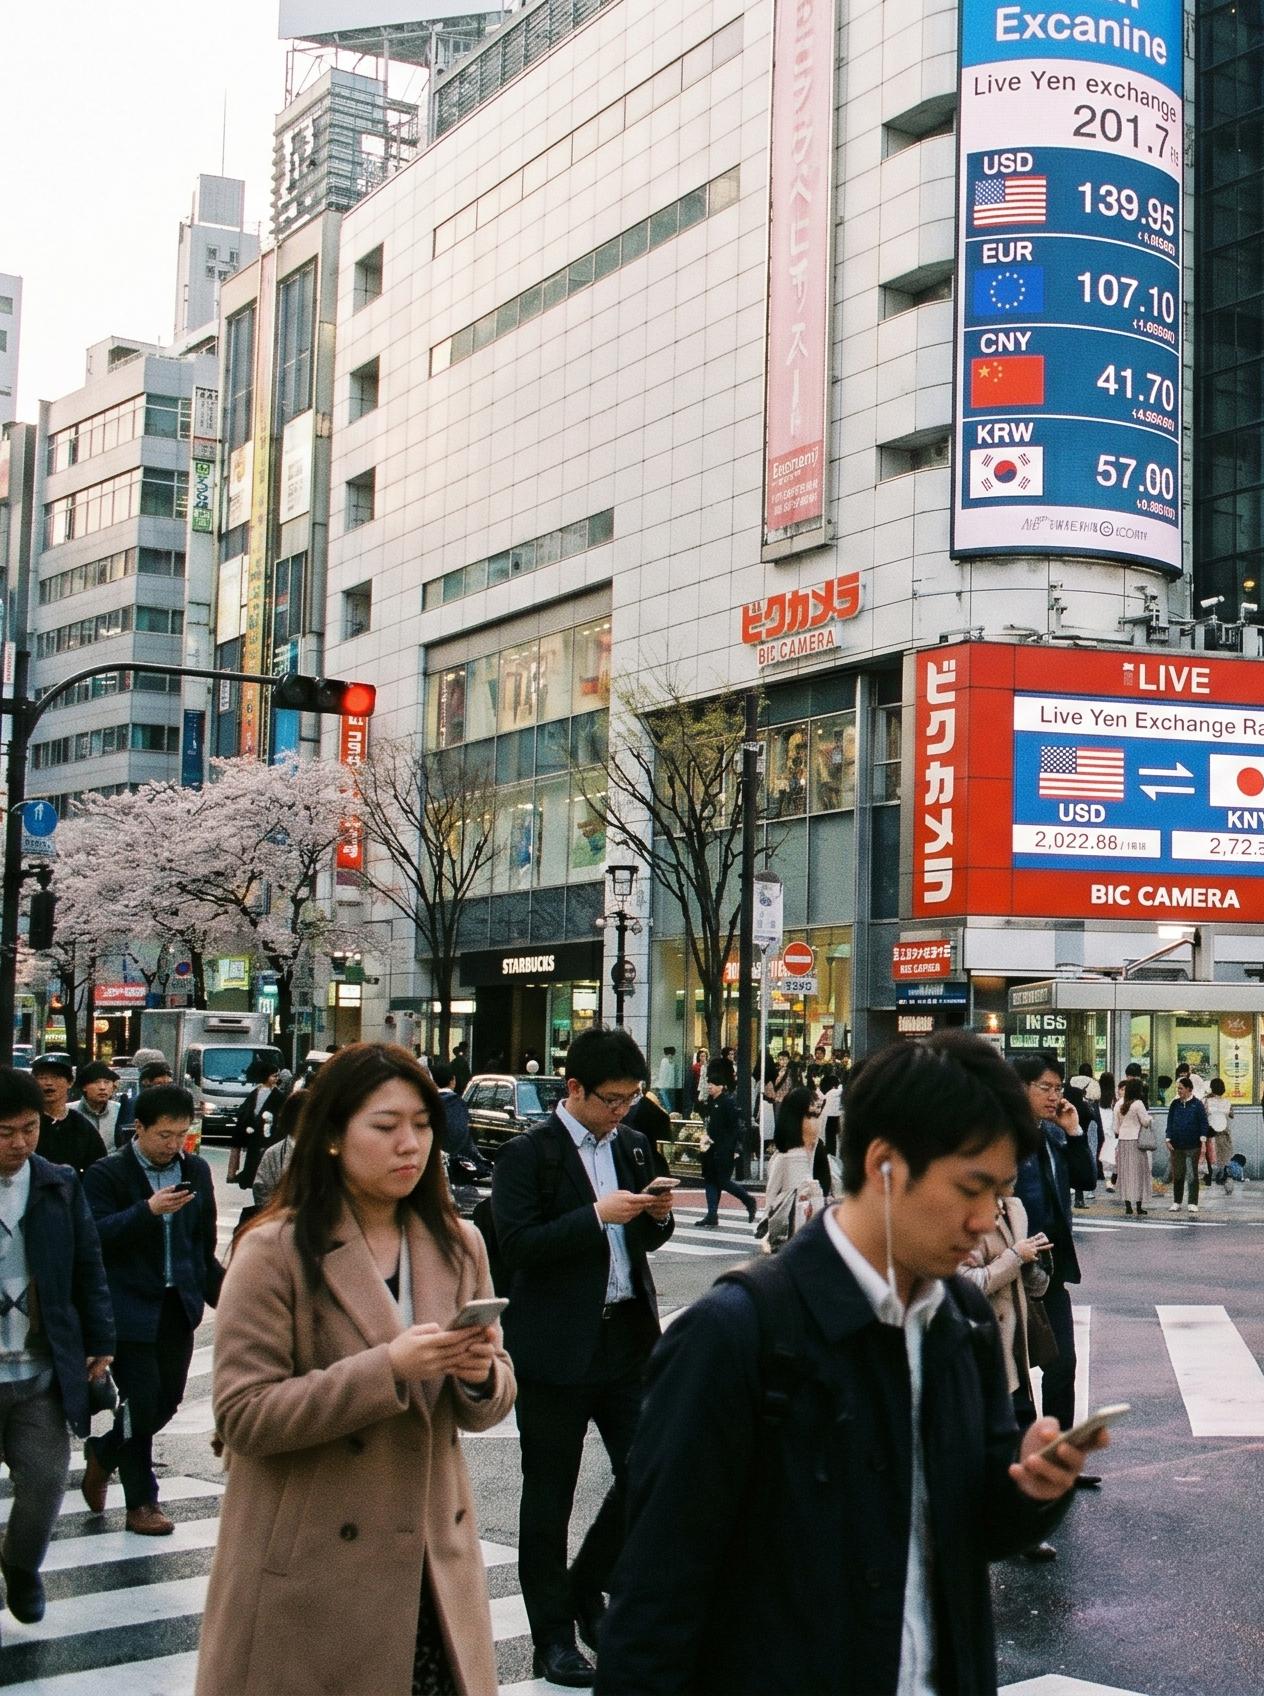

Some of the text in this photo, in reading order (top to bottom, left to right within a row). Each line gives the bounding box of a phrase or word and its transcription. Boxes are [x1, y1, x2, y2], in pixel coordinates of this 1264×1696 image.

[995, 6, 1168, 66] Excanine
[974, 71, 1177, 123] Live Yen exchange
[1072, 104, 1170, 158] 201.7
[983, 152, 1033, 175] USD
[1078, 182, 1174, 237] 139.95
[982, 241, 1033, 264] EUR
[1077, 271, 1175, 324] 107.10
[980, 331, 1032, 354] CNY
[1096, 364, 1174, 411] 41.70
[976, 422, 1034, 444] KRW
[1096, 454, 1174, 500] 57.00
[779, 629, 835, 660] CAMERA
[1139, 663, 1211, 694] LIVE
[1040, 705, 1083, 725] Live
[1090, 708, 1128, 728] Yen
[1135, 711, 1236, 738] Exchange
[923, 658, 957, 904] ビクカメラ
[1059, 802, 1107, 823] USD
[1034, 830, 1119, 851] 2,022.88
[1091, 884, 1241, 909] BIC CAMERA
[502, 954, 555, 975] STARBUCKS
